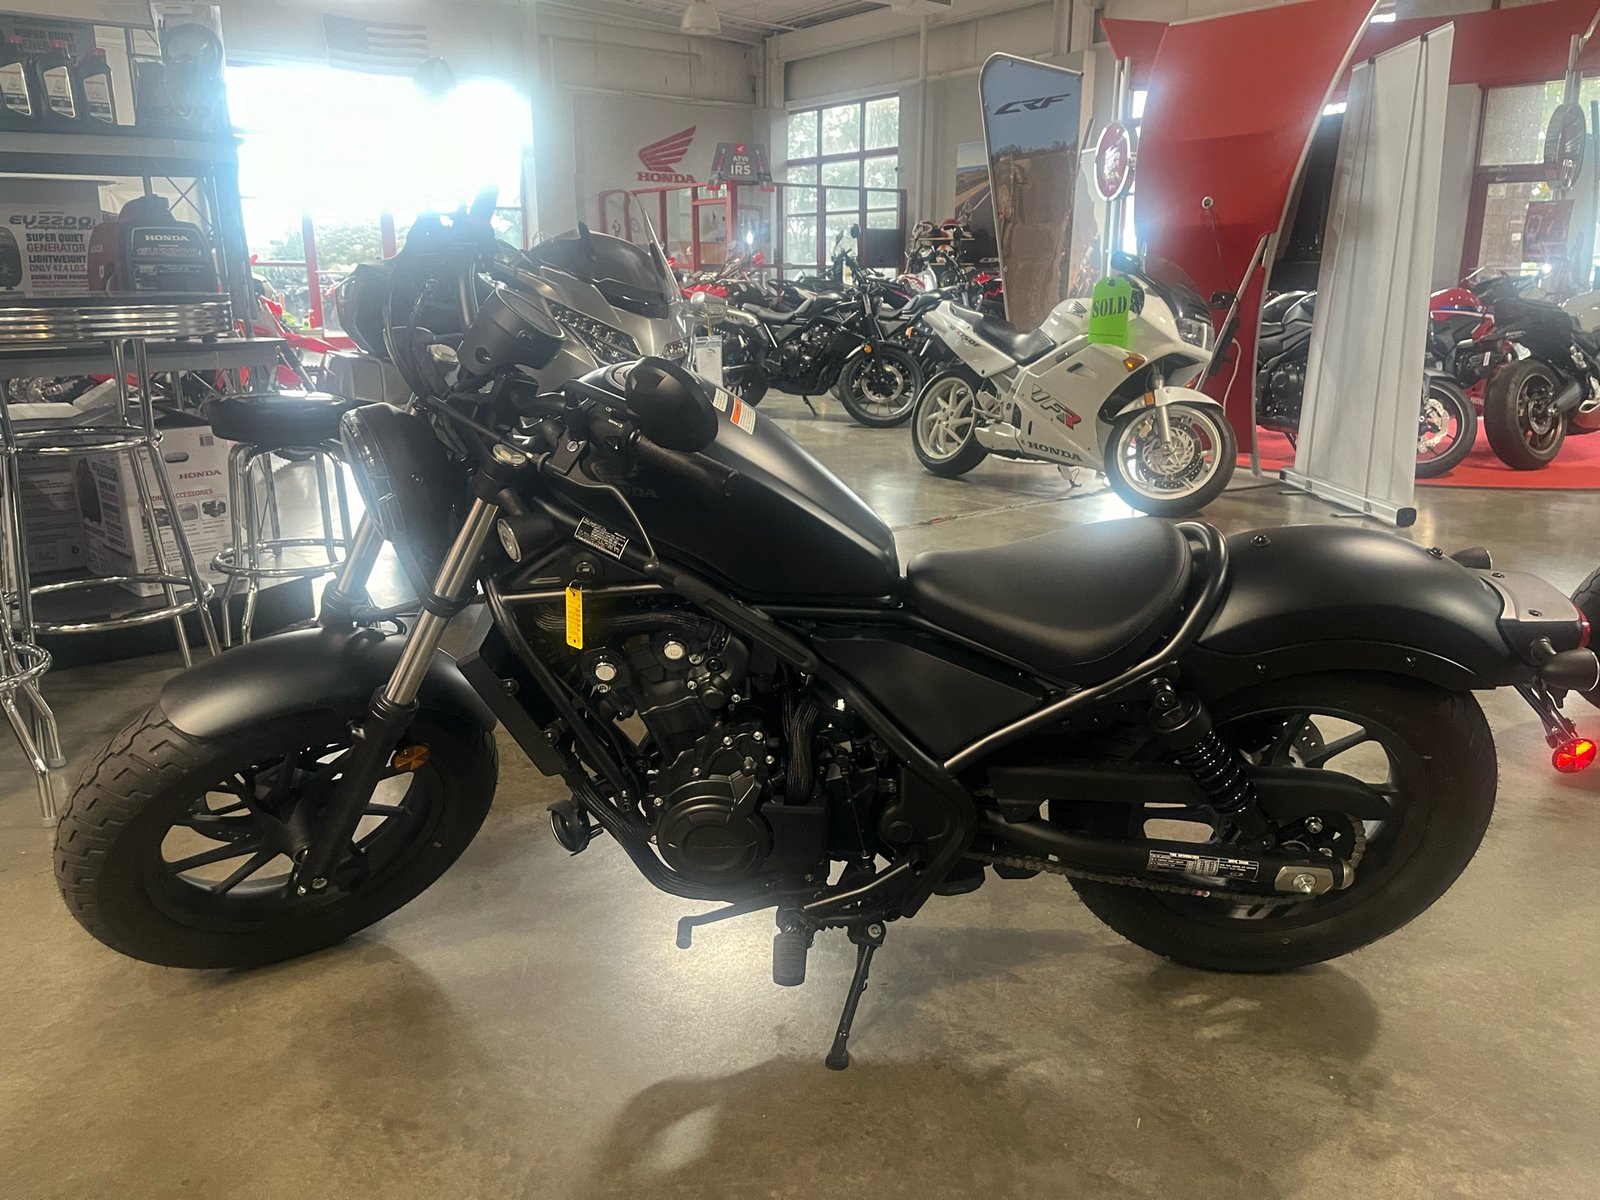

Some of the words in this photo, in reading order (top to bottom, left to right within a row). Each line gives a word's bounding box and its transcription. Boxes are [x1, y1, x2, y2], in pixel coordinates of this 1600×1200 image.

[994, 93, 1071, 115] CRF
[730, 164, 751, 175] IRS
[637, 172, 696, 183] HONDA
[26, 233, 57, 242] SUPER
[58, 234, 84, 243] QUIET
[26, 243, 86, 253] GENERATOR
[28, 255, 86, 263] LIGHTWEIGHT
[30, 264, 51, 272] ONLY
[1093, 296, 1127, 318] SOLD
[1031, 383, 1081, 430] VFR
[1027, 441, 1083, 462] HONDA
[179, 470, 222, 479] HONDA
[175, 488, 214, 499] CCESSORIES
